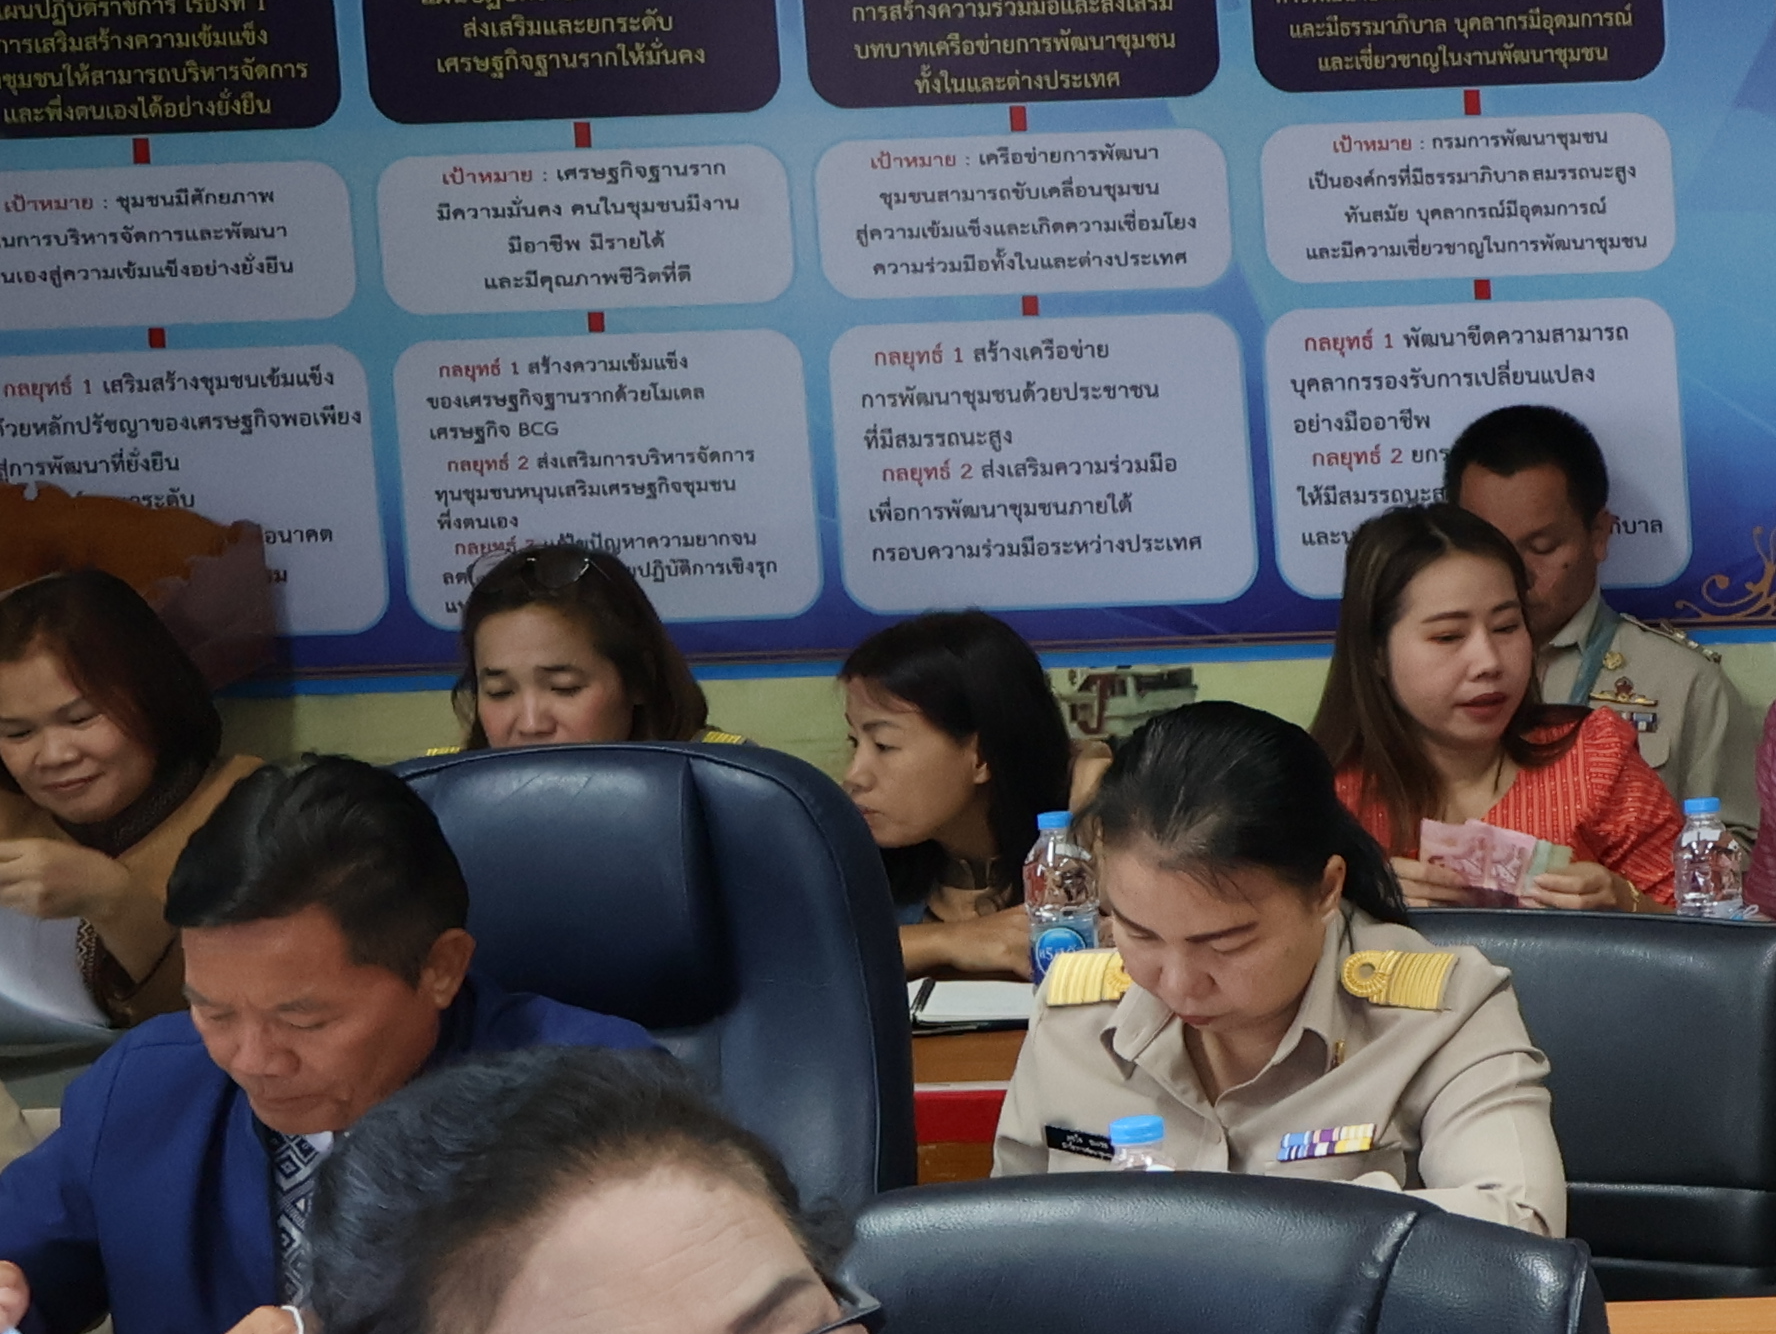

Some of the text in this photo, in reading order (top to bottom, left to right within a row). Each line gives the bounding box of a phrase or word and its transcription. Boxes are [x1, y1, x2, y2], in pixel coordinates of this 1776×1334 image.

[518, 419, 559, 437] BCG
[1390, 447, 1403, 466] 2
[960, 462, 974, 481] 2
